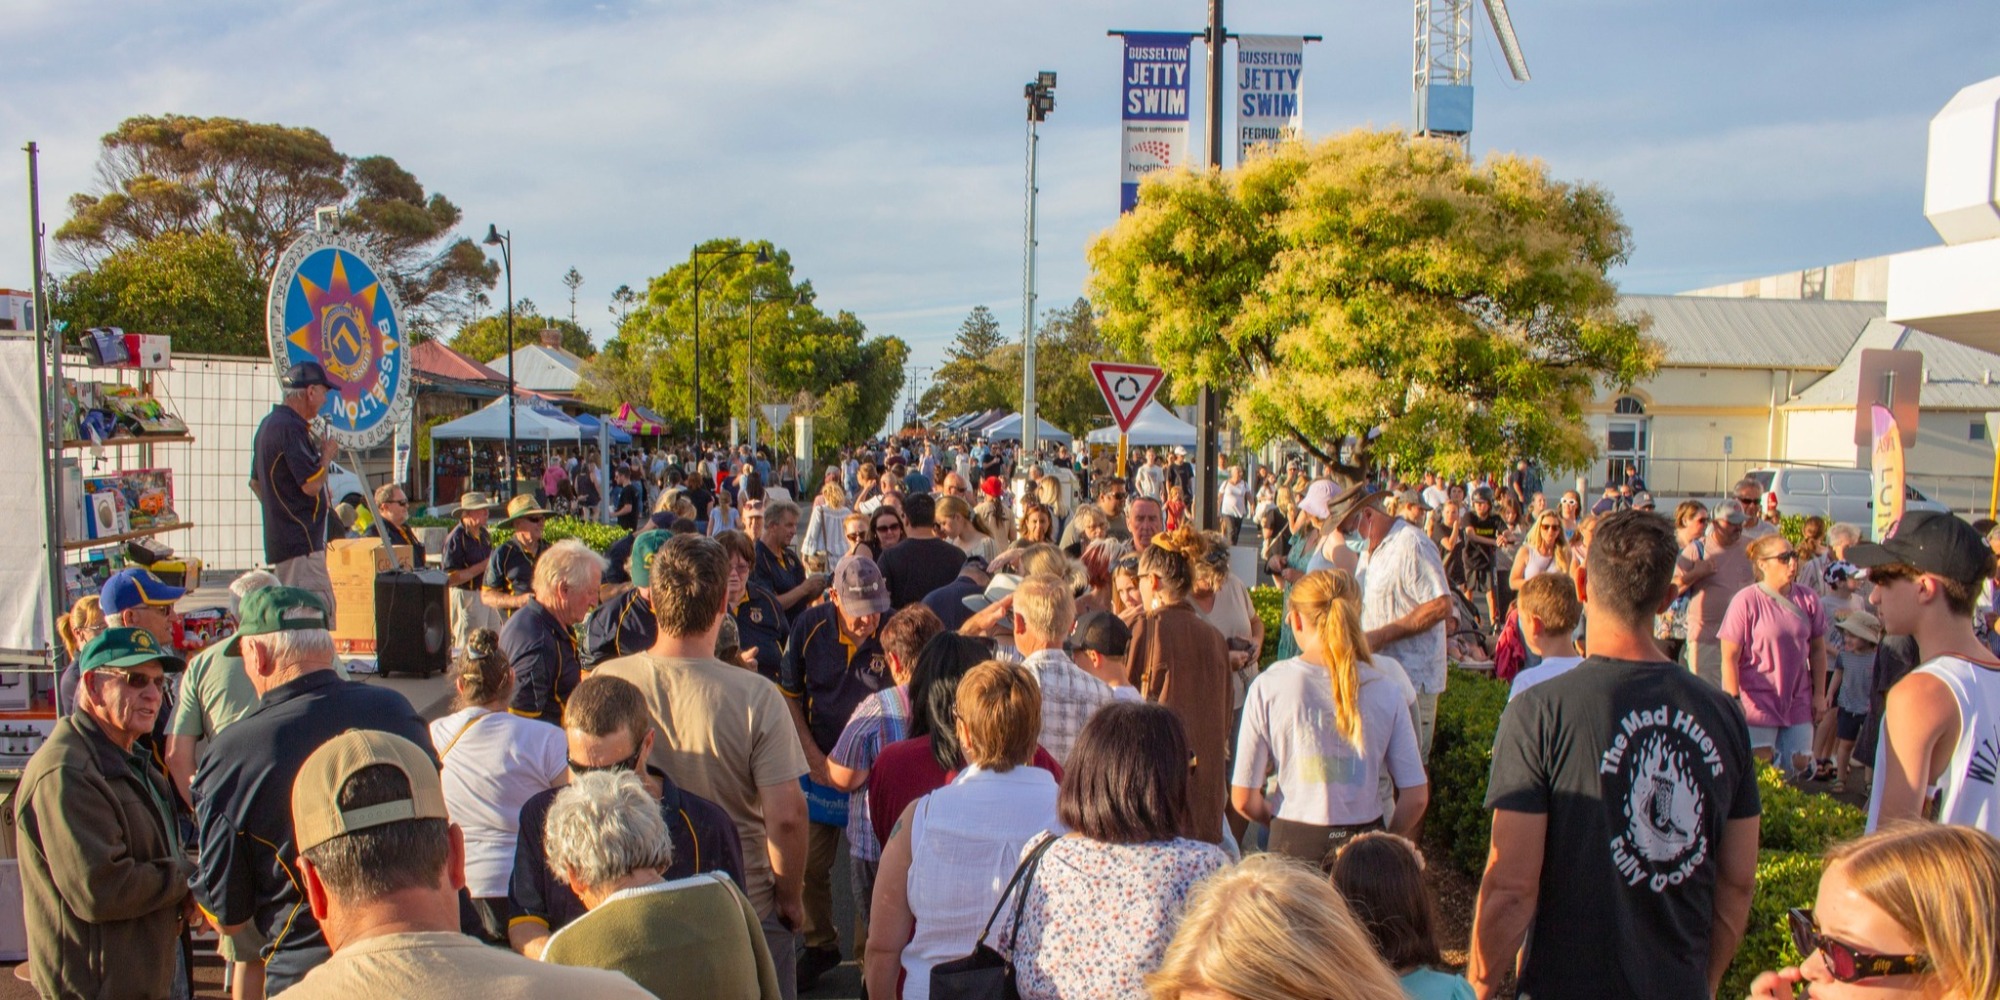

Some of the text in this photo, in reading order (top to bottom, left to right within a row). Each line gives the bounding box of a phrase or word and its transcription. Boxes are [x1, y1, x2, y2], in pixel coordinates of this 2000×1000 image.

[1128, 47, 1187, 61] BUSSELTON
[1239, 51, 1301, 65] BUSSELTON
[1128, 63, 1186, 86] JETTY
[1240, 68, 1299, 90] JETTY
[1128, 88, 1186, 115] SWIM
[1242, 93, 1298, 117] SWIM
[333, 317, 395, 420] BUSSELTON
[1600, 705, 1724, 778] The Mad Hueys
[1610, 835, 1648, 887] Fully
